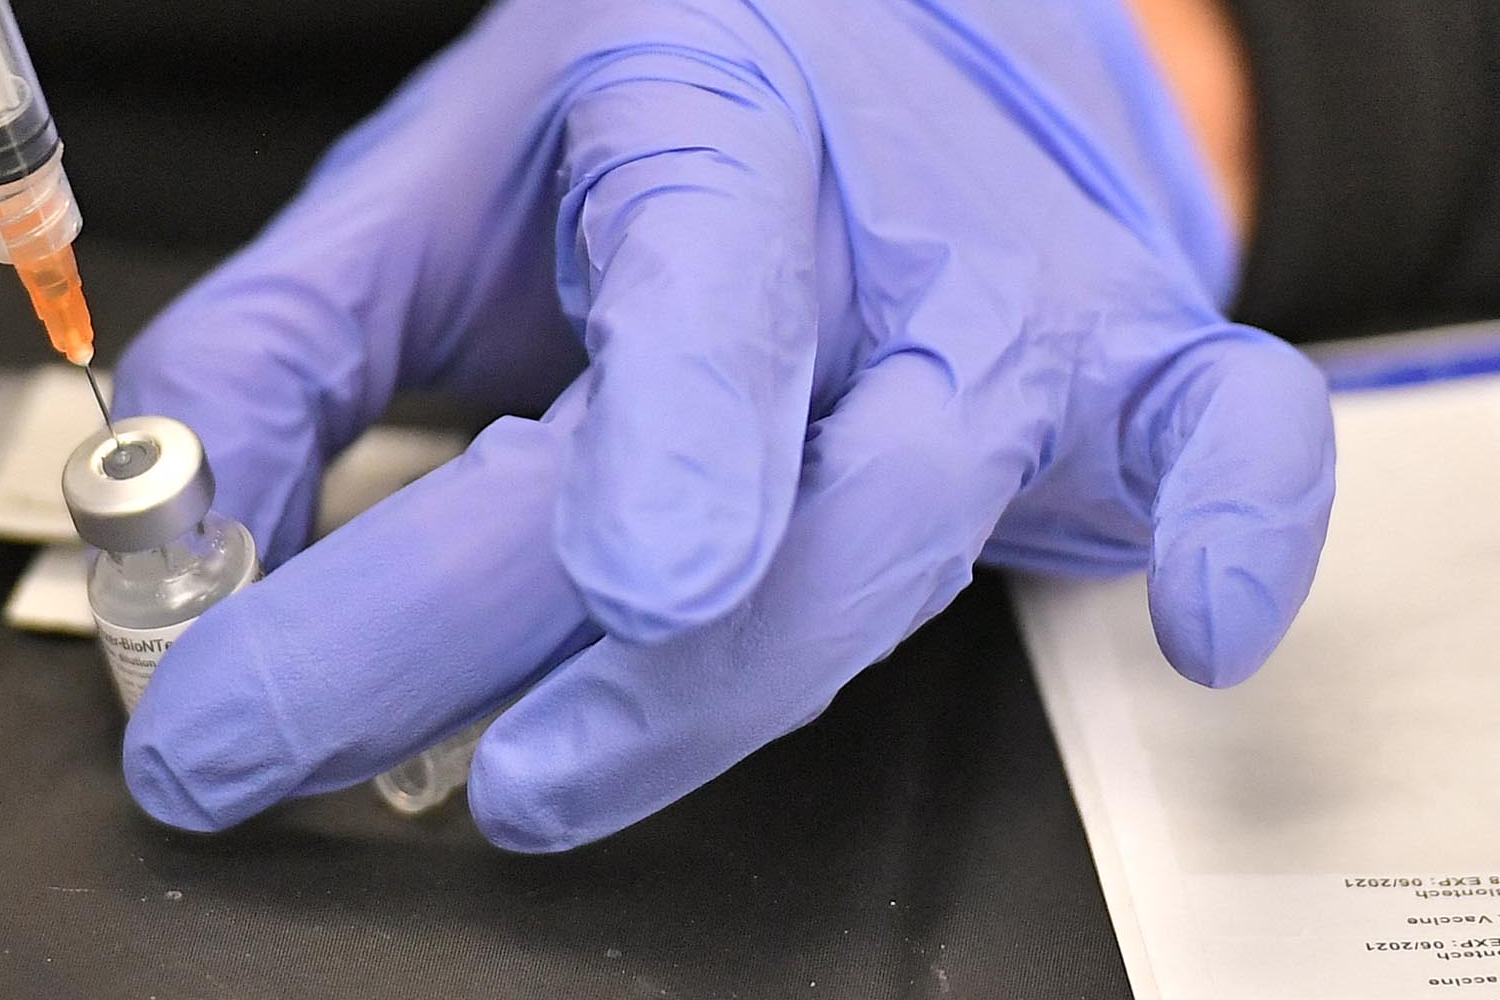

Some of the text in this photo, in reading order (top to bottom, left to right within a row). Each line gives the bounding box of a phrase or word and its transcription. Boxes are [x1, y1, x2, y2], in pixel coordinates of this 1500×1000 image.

[1344, 877, 1423, 888] 06/2021
[1430, 876, 1481, 887] EXP:
[1407, 914, 1493, 926] Vaccine
[1364, 941, 1444, 951] 06/2021
